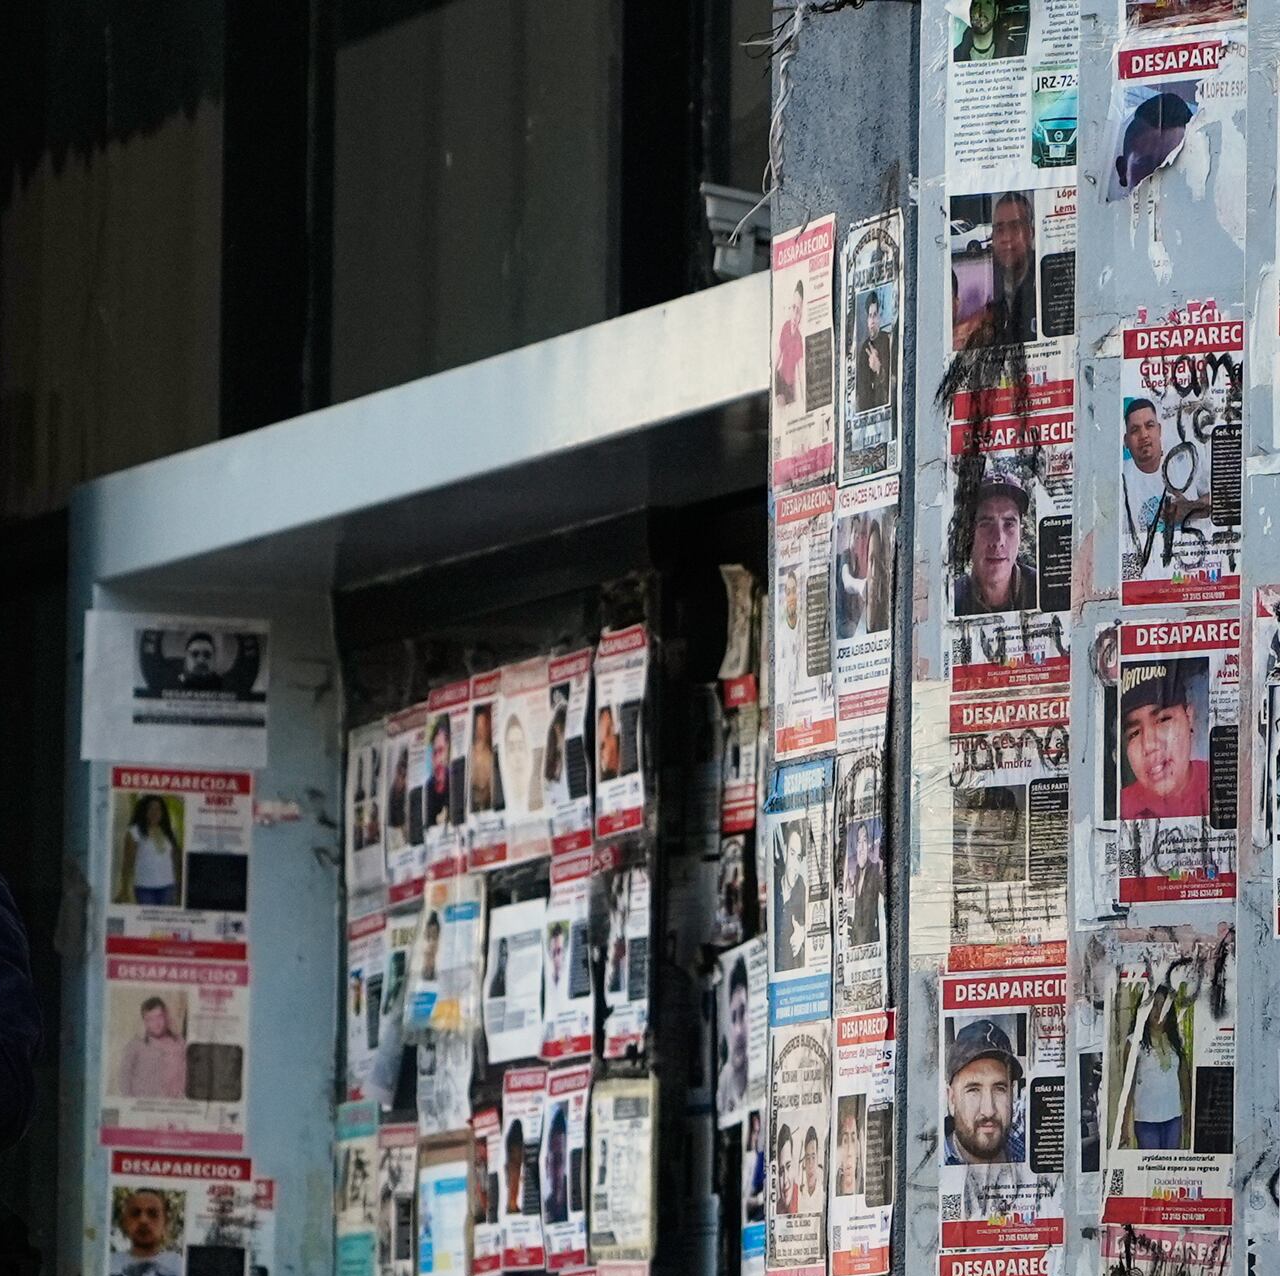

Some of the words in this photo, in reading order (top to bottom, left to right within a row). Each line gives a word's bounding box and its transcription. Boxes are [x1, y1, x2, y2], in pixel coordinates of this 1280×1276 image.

[779, 234, 829, 265] DESAPARECIDO
[1137, 325, 1241, 350] DESAPAREC
[1137, 622, 1239, 645] DESAPAREC
[122, 773, 237, 790] DESAPARECIDA
[123, 1159, 241, 1178] DESAPARECIDO
